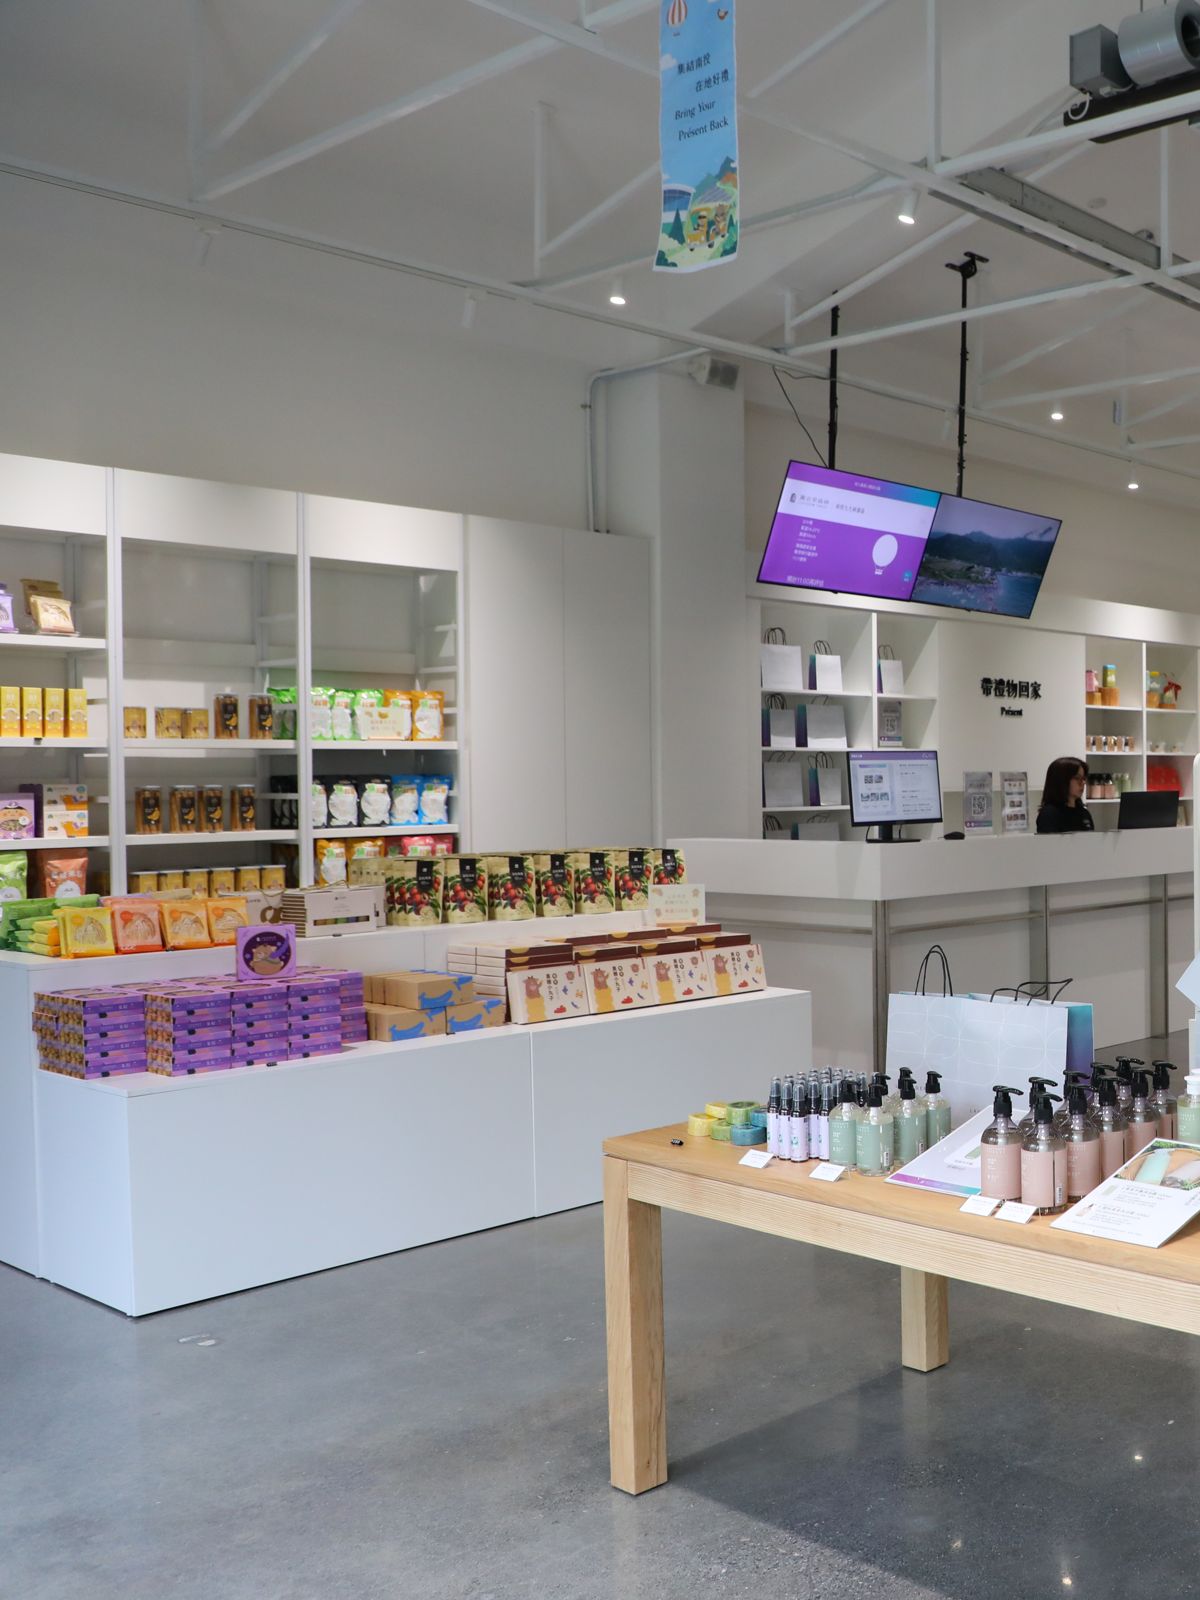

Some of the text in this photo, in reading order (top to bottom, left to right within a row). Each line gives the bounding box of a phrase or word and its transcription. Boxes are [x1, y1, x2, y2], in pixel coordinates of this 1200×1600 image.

[677, 52, 712, 75] 集結南投
[695, 69, 730, 93] 在地好禮
[675, 100, 716, 121] Bring Your
[678, 116, 729, 141] Présent Back
[981, 677, 1042, 700] 帶禮物回家
